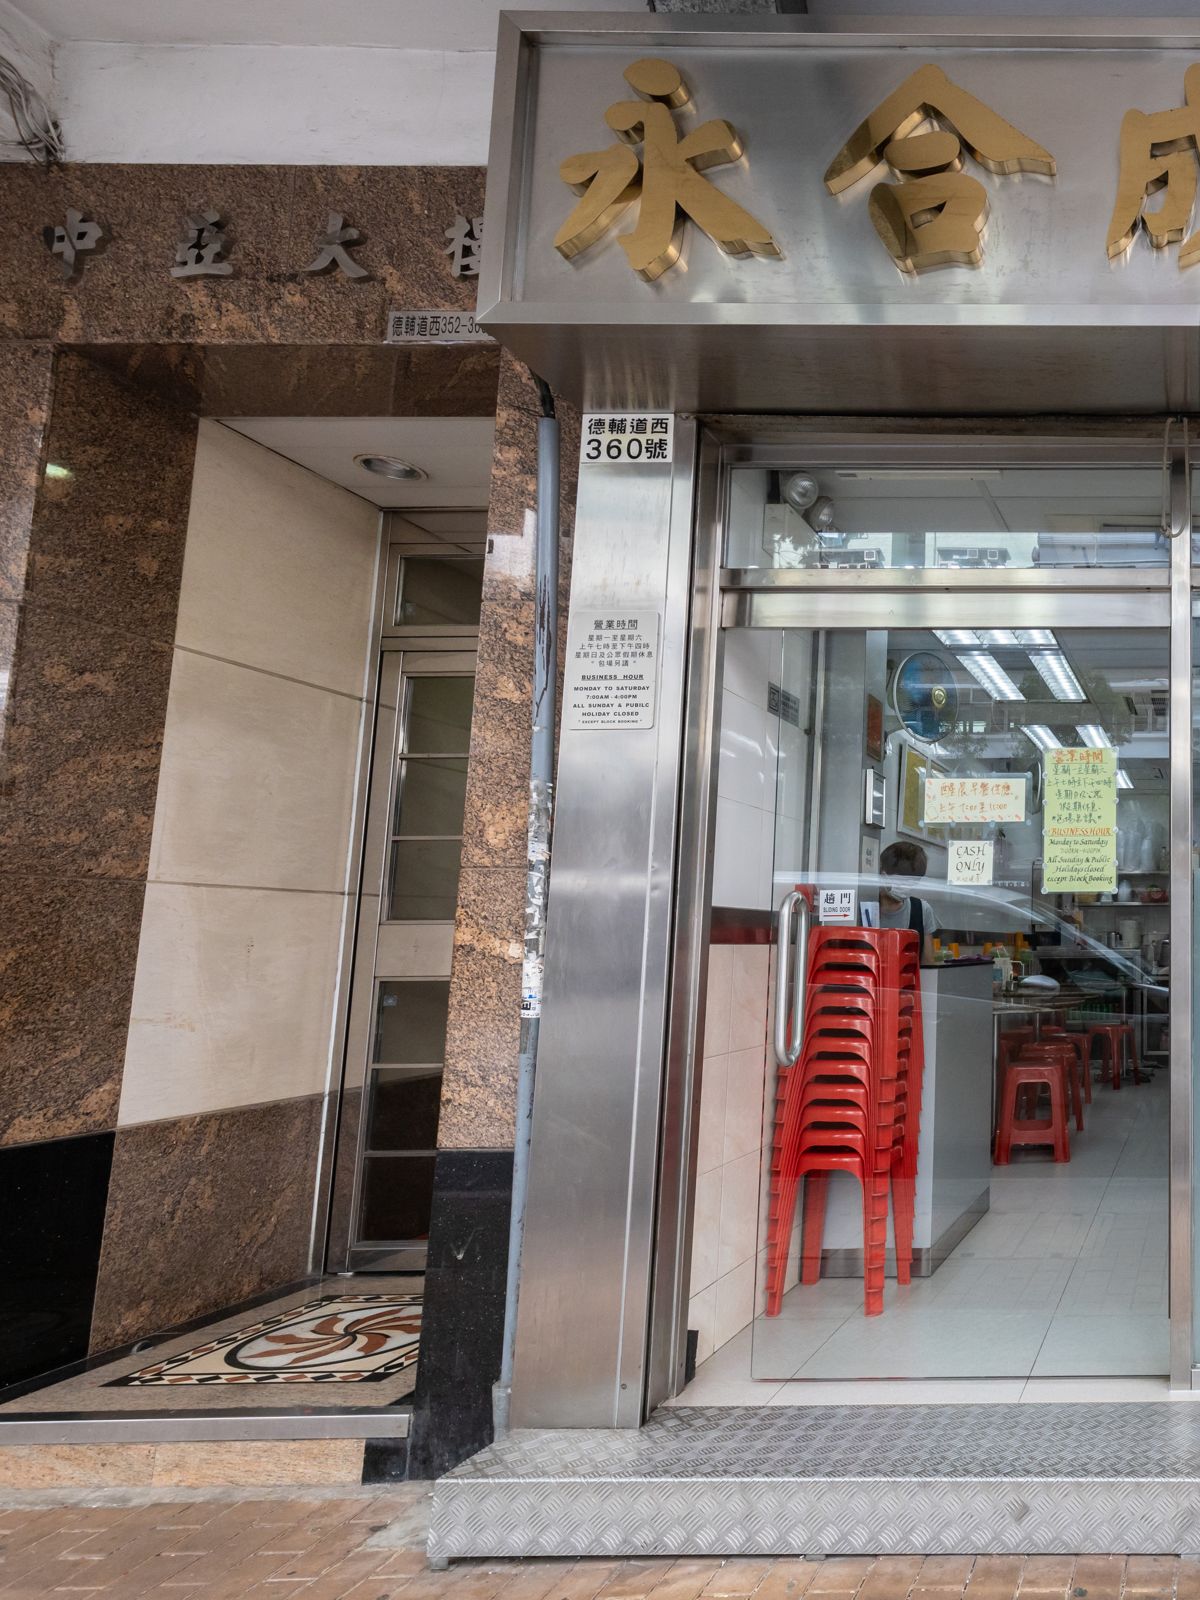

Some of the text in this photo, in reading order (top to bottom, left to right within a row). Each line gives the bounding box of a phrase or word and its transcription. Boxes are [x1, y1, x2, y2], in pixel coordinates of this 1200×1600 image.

[587, 418, 669, 435] 德輔道西
[585, 438, 668, 460] 360號
[594, 619, 638, 631] 營業時間
[1053, 750, 1103, 765] 營業時間
[1050, 827, 1089, 836] BUSINESS
[1048, 838, 1073, 847] Monday
[1080, 837, 1109, 848] Saturday
[956, 842, 987, 858] CASH
[955, 859, 985, 873] ONLY
